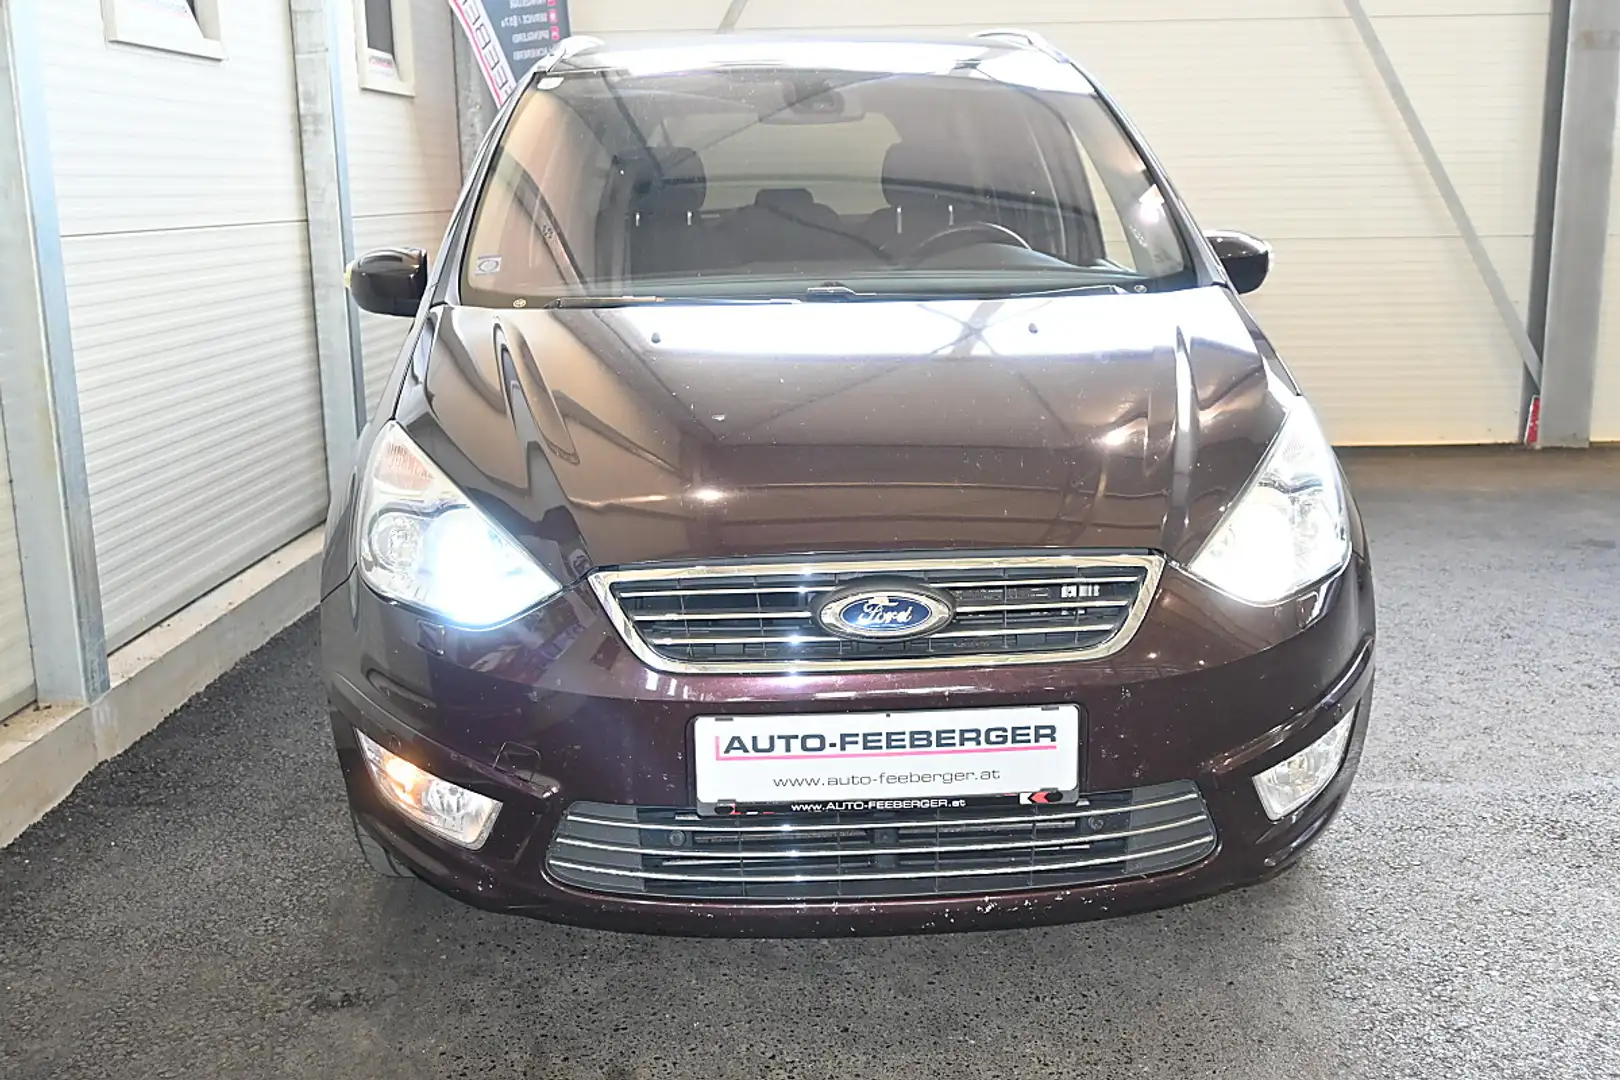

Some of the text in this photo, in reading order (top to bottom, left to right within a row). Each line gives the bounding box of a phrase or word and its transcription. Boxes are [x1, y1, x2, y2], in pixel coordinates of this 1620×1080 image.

[857, 597, 913, 624] Ford
[723, 724, 1057, 755] AUTO-FEEBERGER
[772, 768, 1001, 788] www.auto-feeberger.at
[790, 798, 966, 812] www.AUTO-FEEBERGER.at
